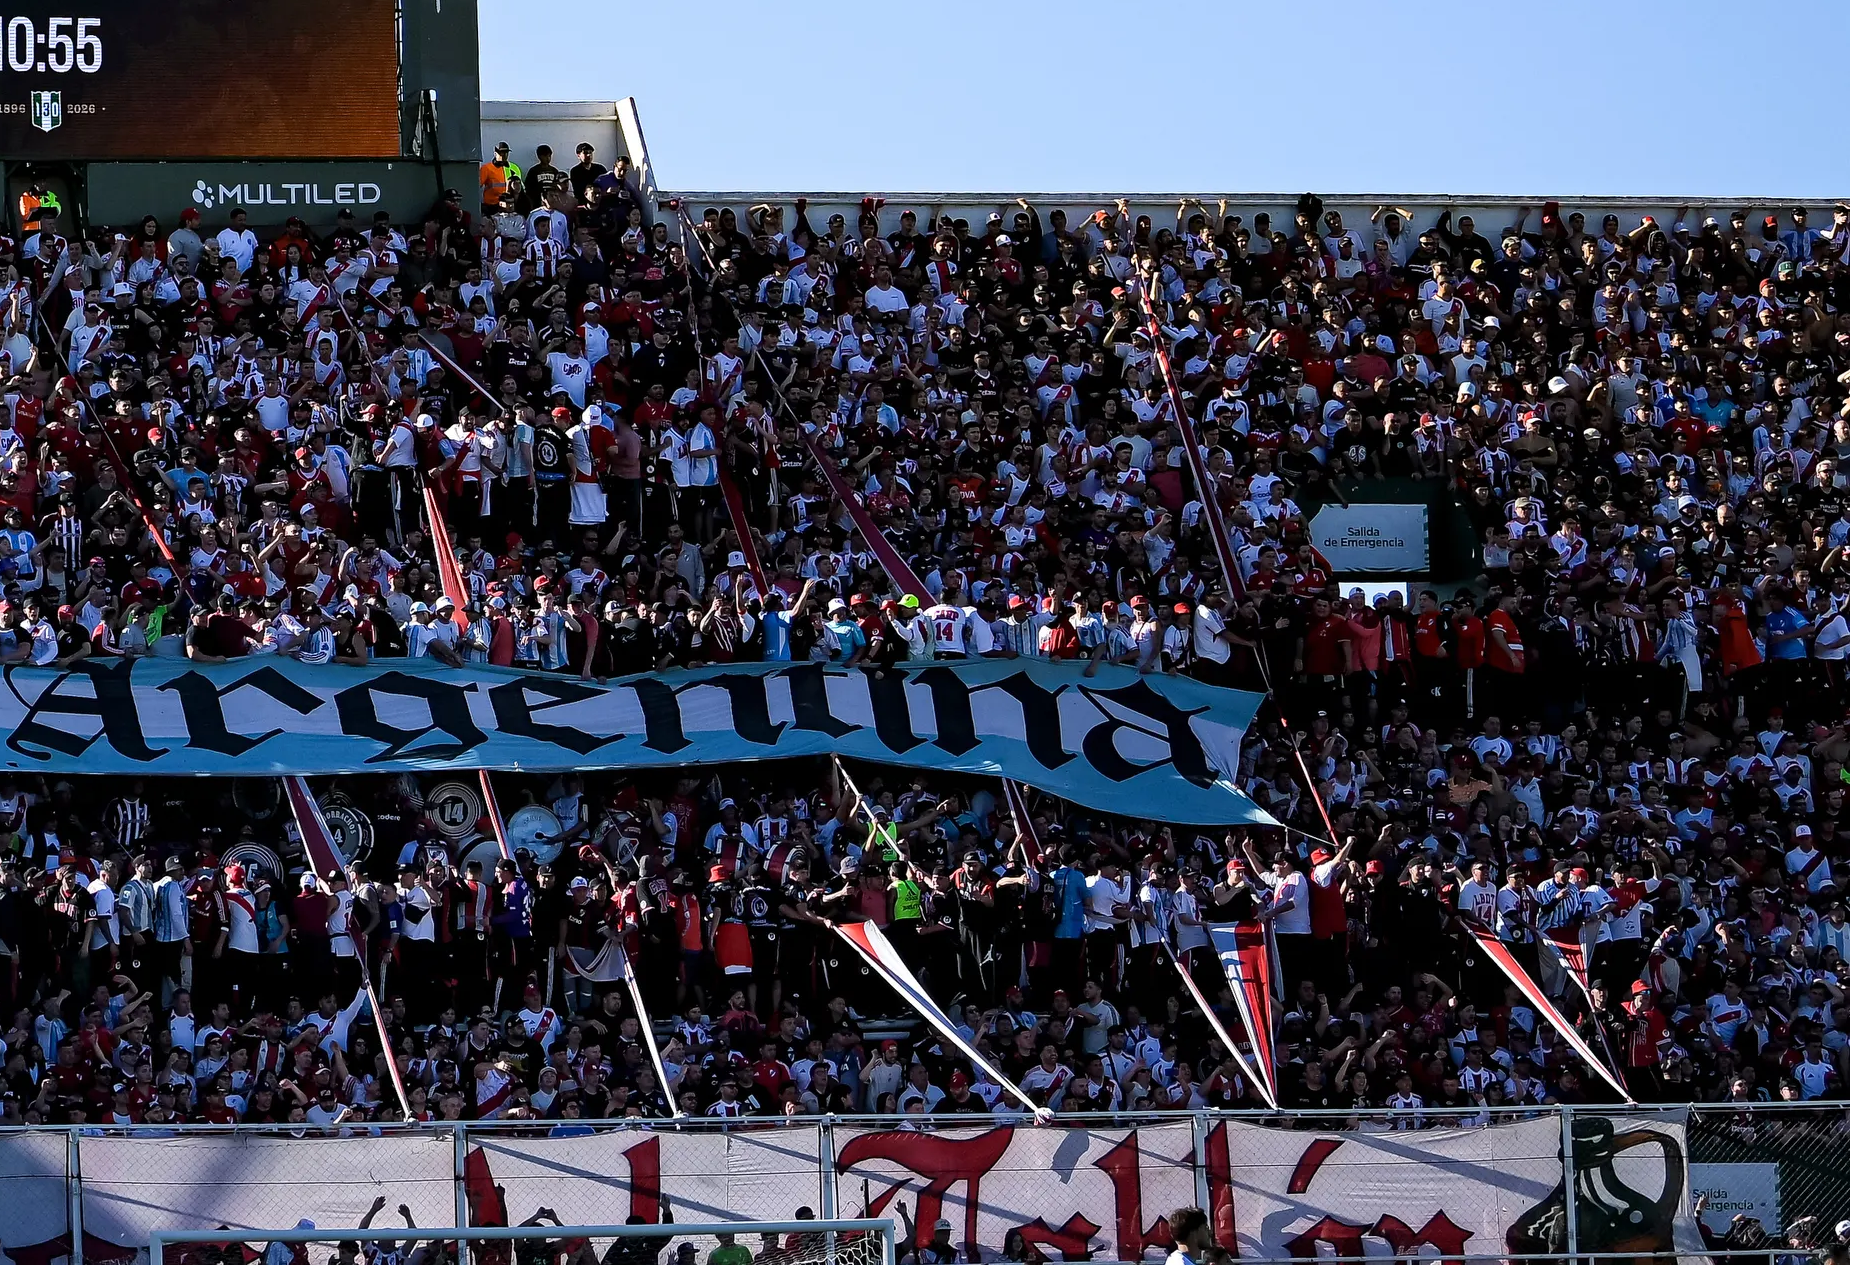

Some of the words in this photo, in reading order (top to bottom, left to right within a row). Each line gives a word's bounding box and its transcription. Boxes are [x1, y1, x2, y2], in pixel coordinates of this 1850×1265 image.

[35, 101, 59, 117] 130
[67, 104, 96, 114] 2026
[218, 183, 381, 205] MULTILED
[1347, 527, 1379, 537] Salida
[1324, 537, 1338, 547] de
[1341, 537, 1404, 549] Emergencia
[935, 622, 953, 641] 14
[3, 655, 1243, 789] Argentina
[444, 802, 464, 823] 14
[1693, 1199, 1754, 1212] ergencia
